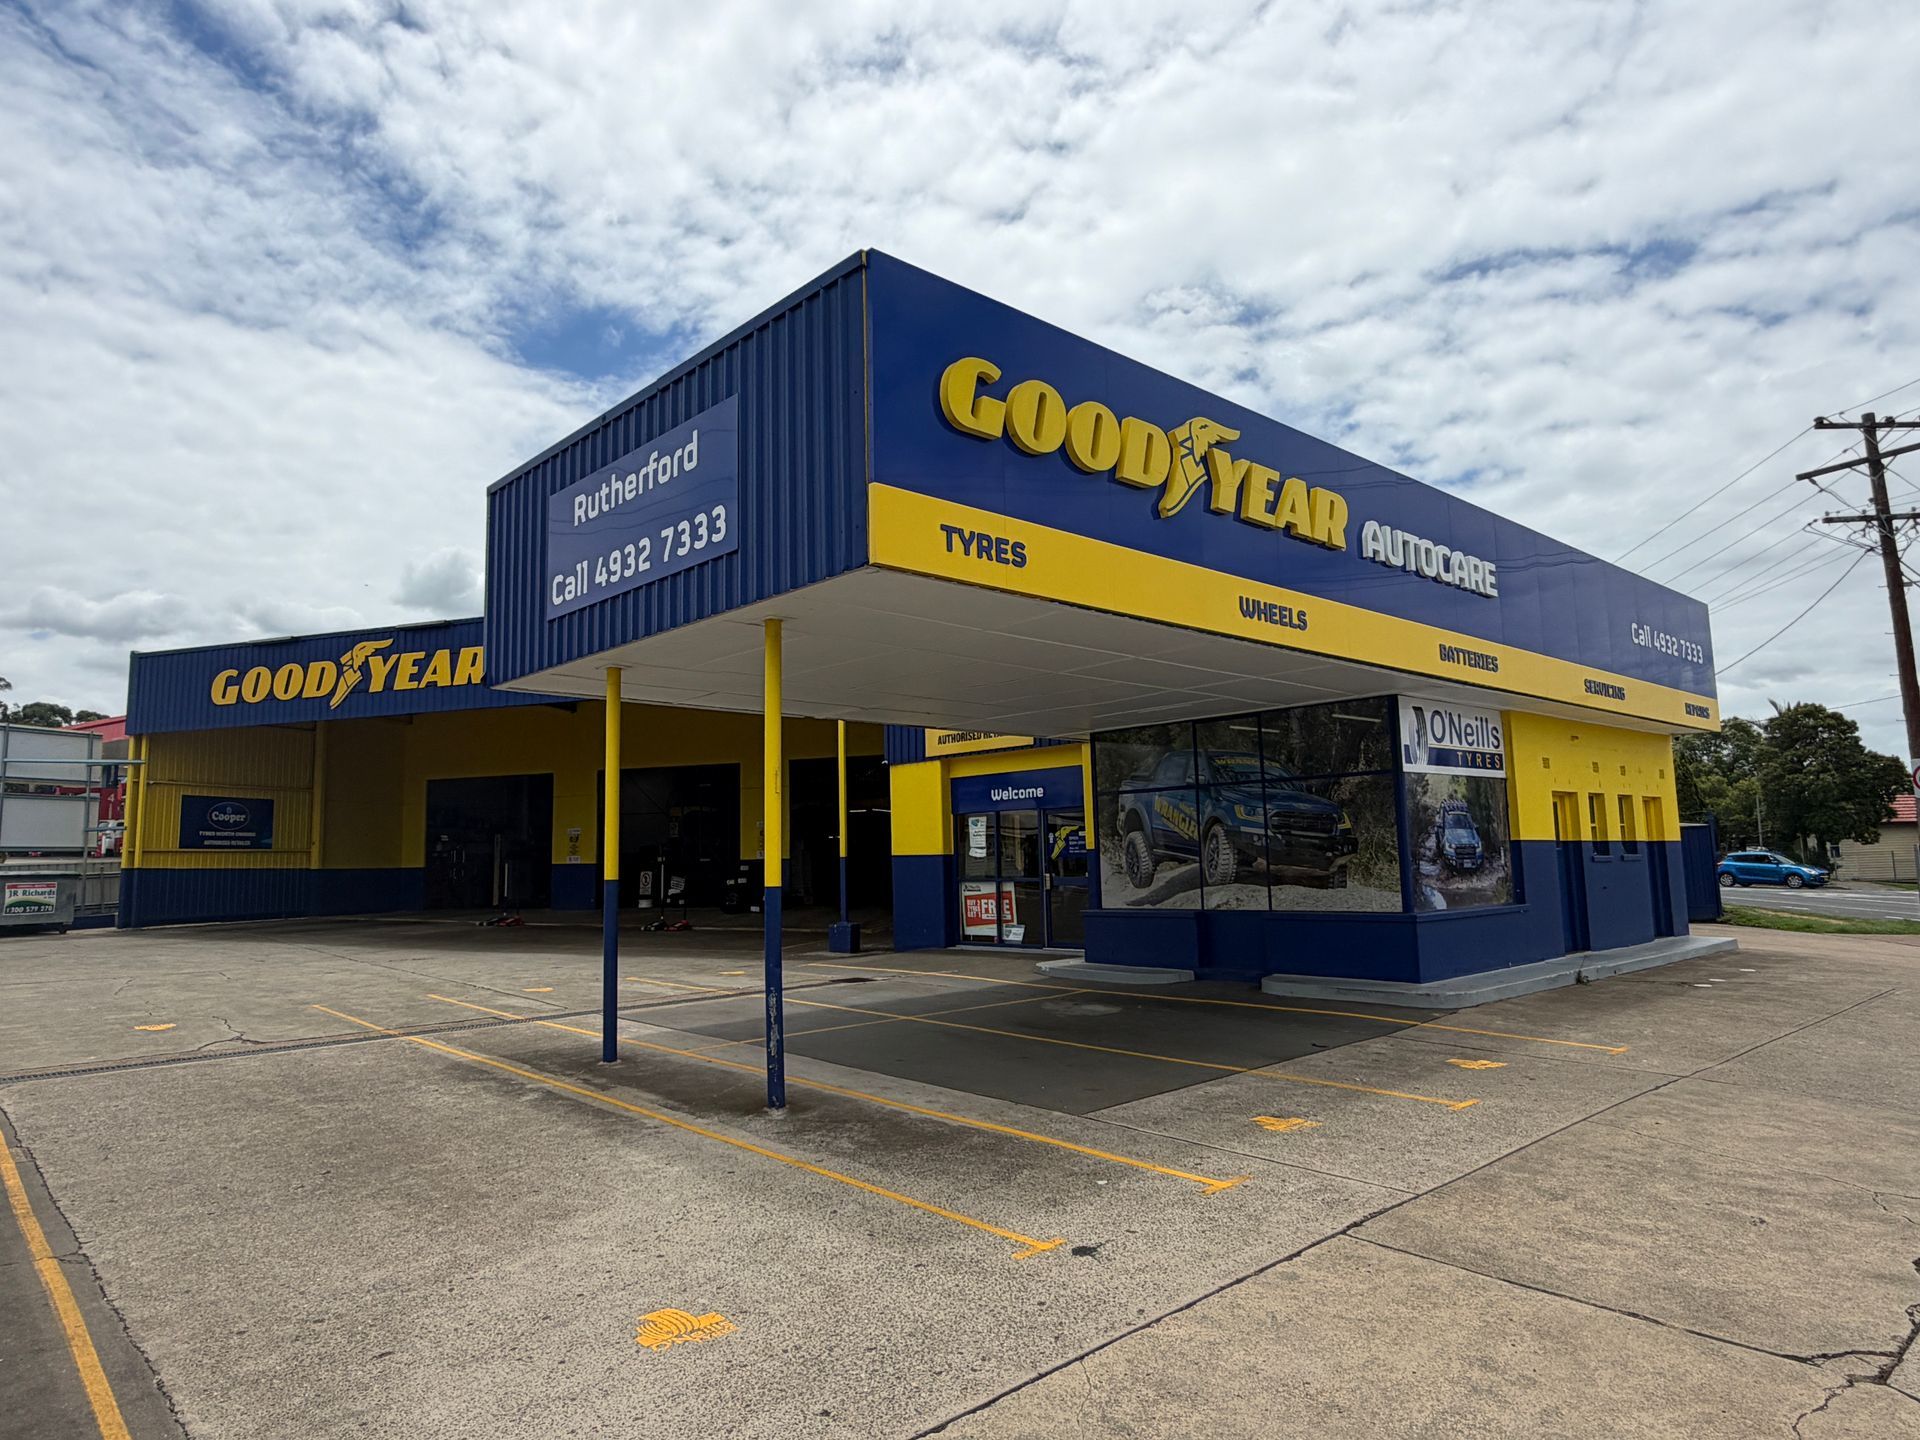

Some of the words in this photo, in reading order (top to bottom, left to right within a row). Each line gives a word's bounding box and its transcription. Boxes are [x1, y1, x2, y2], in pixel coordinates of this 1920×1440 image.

[940, 356, 1348, 550] GOODYEAR
[574, 429, 698, 526] Rutherford
[552, 560, 588, 606] Call
[595, 537, 650, 587] 4932
[661, 504, 726, 563] 7333
[940, 523, 1027, 568] TYRES
[1362, 520, 1498, 597] AUTOCARE
[1239, 595, 1308, 631] WHEELS
[1439, 643, 1499, 673] BATTERIES
[1631, 622, 1651, 649] Call
[1654, 630, 1679, 657] 4932
[1680, 640, 1703, 664] 7333
[211, 645, 484, 706] GOODYEAR
[1584, 678, 1625, 700] SERVICING
[937, 731, 981, 746] AUTHORISED
[1430, 709, 1500, 749] O'Neills
[1457, 751, 1500, 769] TYRES
[991, 786, 1044, 801] Welcome
[211, 811, 246, 824] Cooper
[9, 890, 19, 898] JR
[981, 899, 1011, 914] FRE
